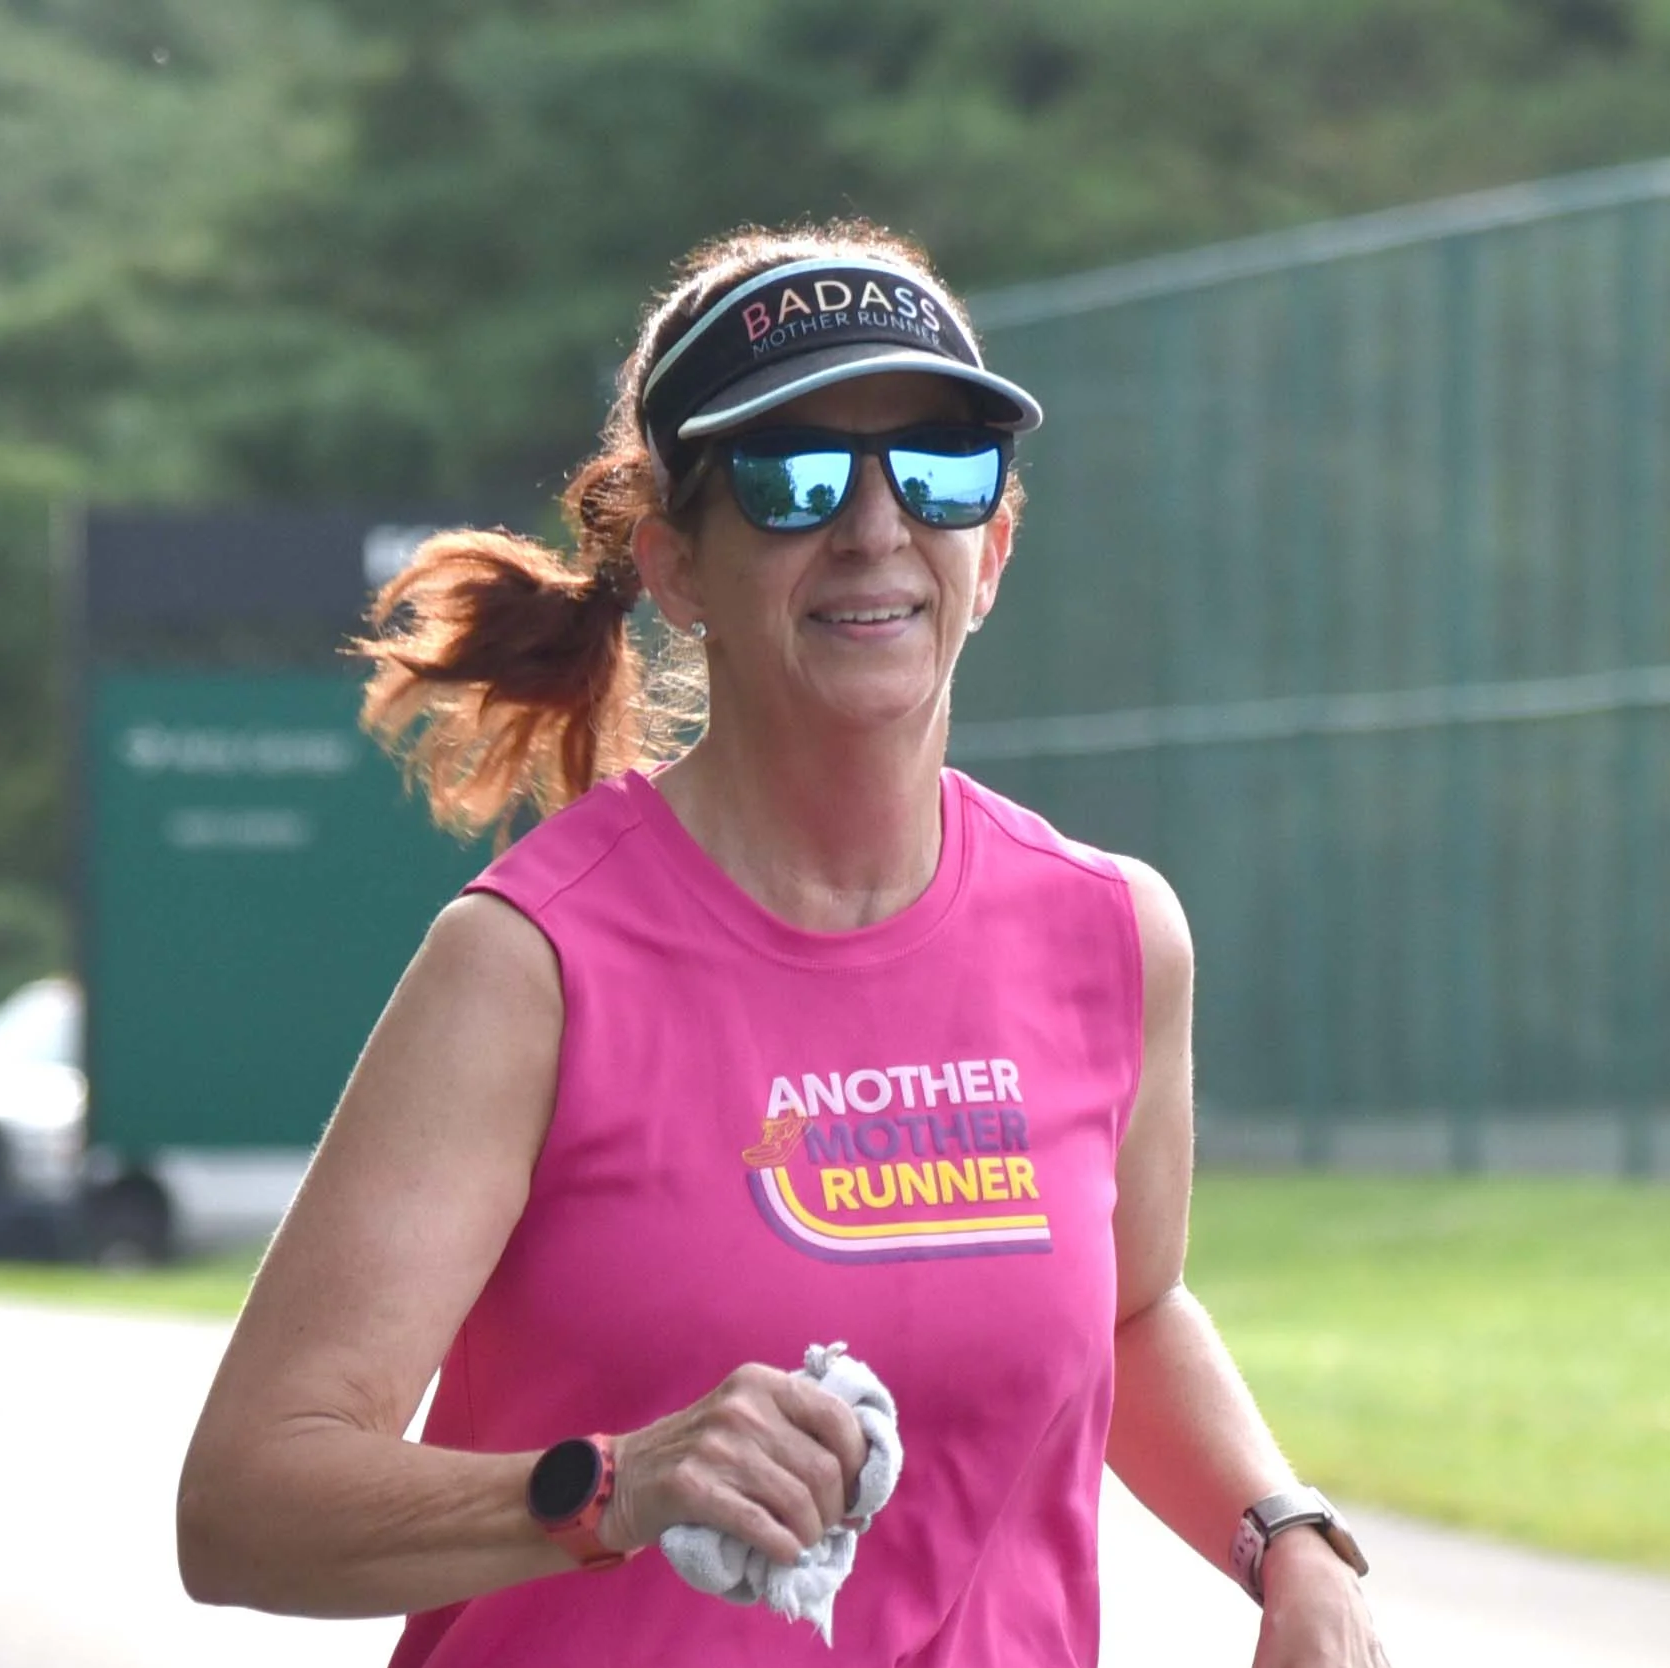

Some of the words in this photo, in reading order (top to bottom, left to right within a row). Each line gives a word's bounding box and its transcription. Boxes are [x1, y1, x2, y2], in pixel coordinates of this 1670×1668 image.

[742, 280, 940, 342] BADASS
[752, 312, 850, 359] MOTHER
[857, 311, 941, 346] RUNNER
[766, 1058, 1023, 1119] ANOTHER
[806, 1108, 1030, 1165] MOTHER
[820, 1156, 1040, 1212] RUNNER
